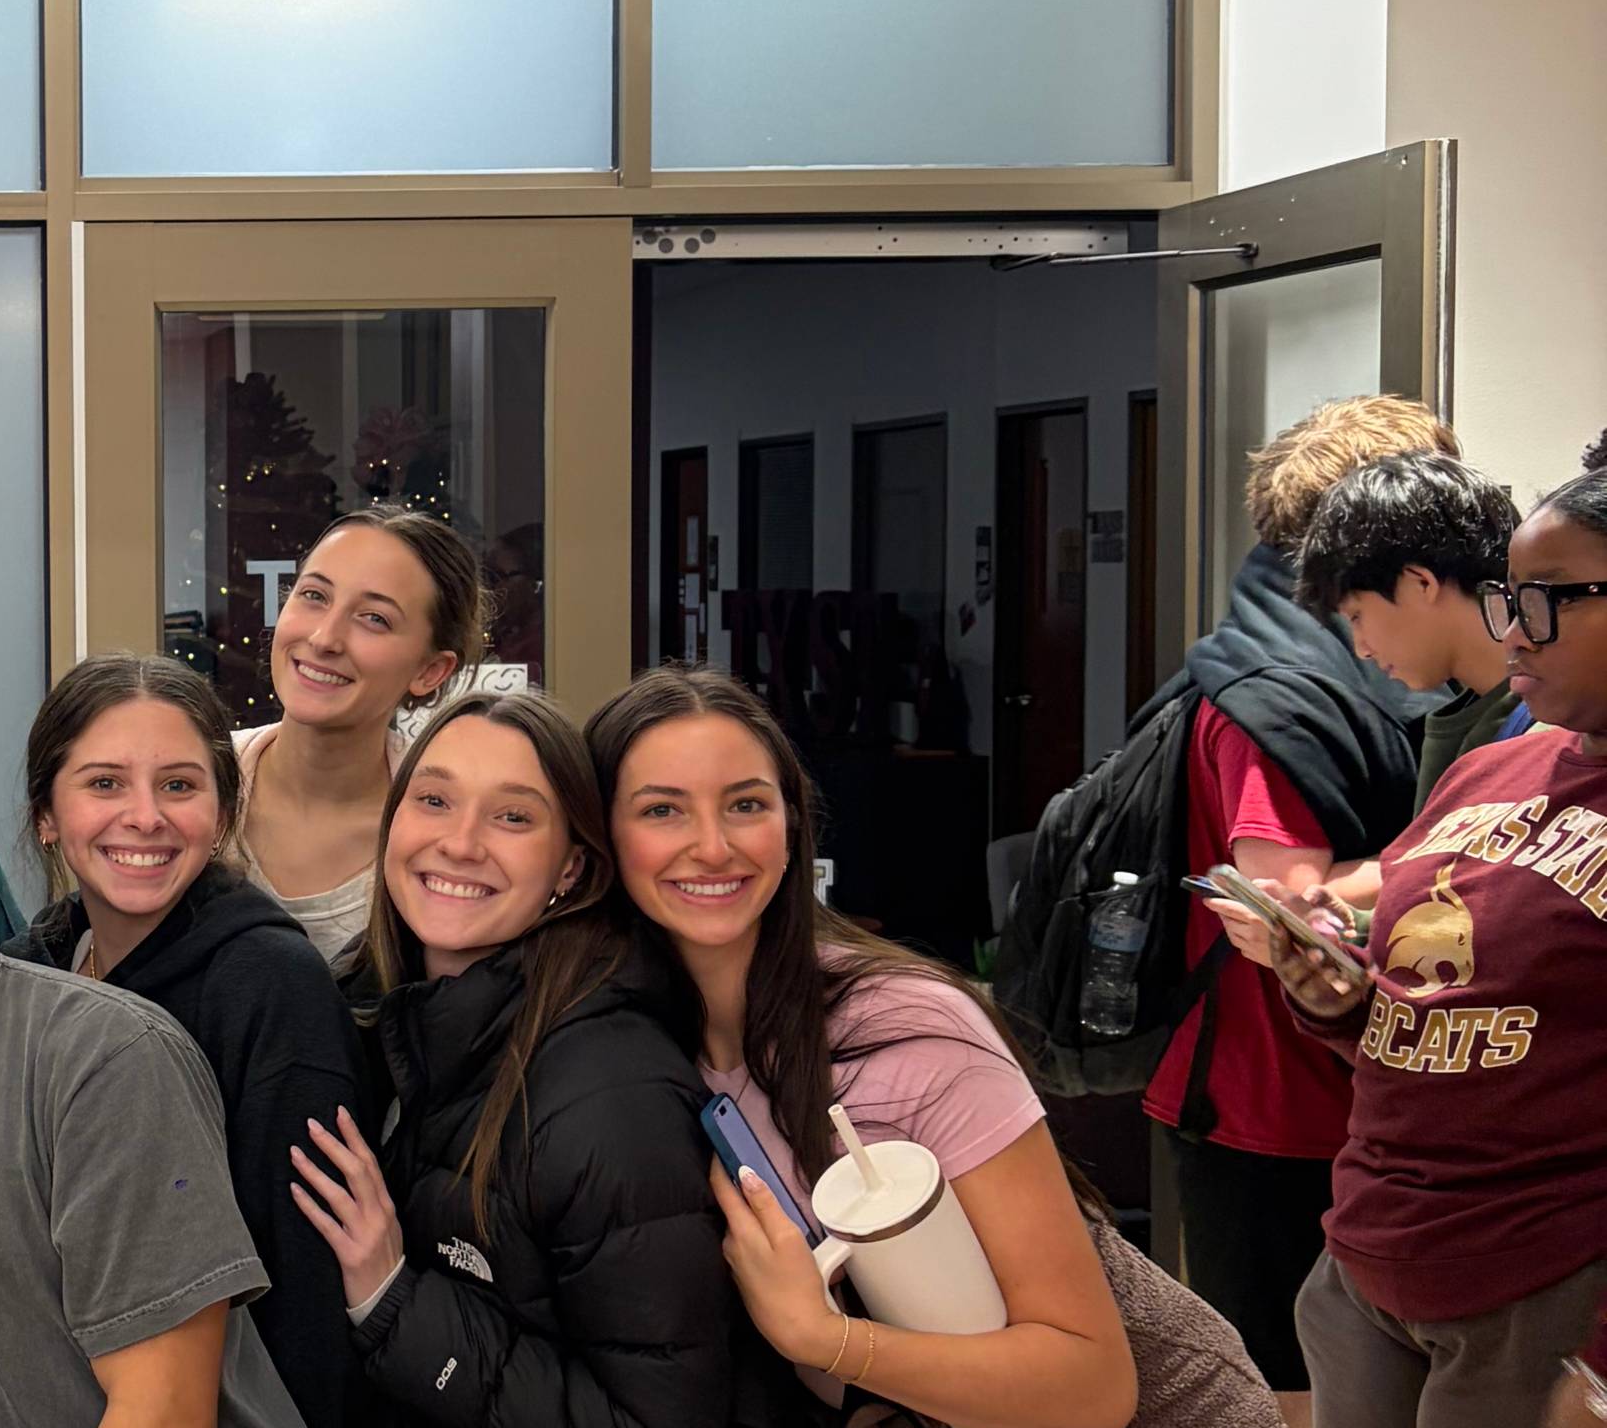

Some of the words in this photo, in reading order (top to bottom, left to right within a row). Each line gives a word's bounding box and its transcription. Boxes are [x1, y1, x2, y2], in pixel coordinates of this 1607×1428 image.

[1362, 988, 1539, 1073] BCATS
[437, 1242, 473, 1263] NORTH
[451, 1236, 471, 1252] THE
[449, 1255, 476, 1275] FACE
